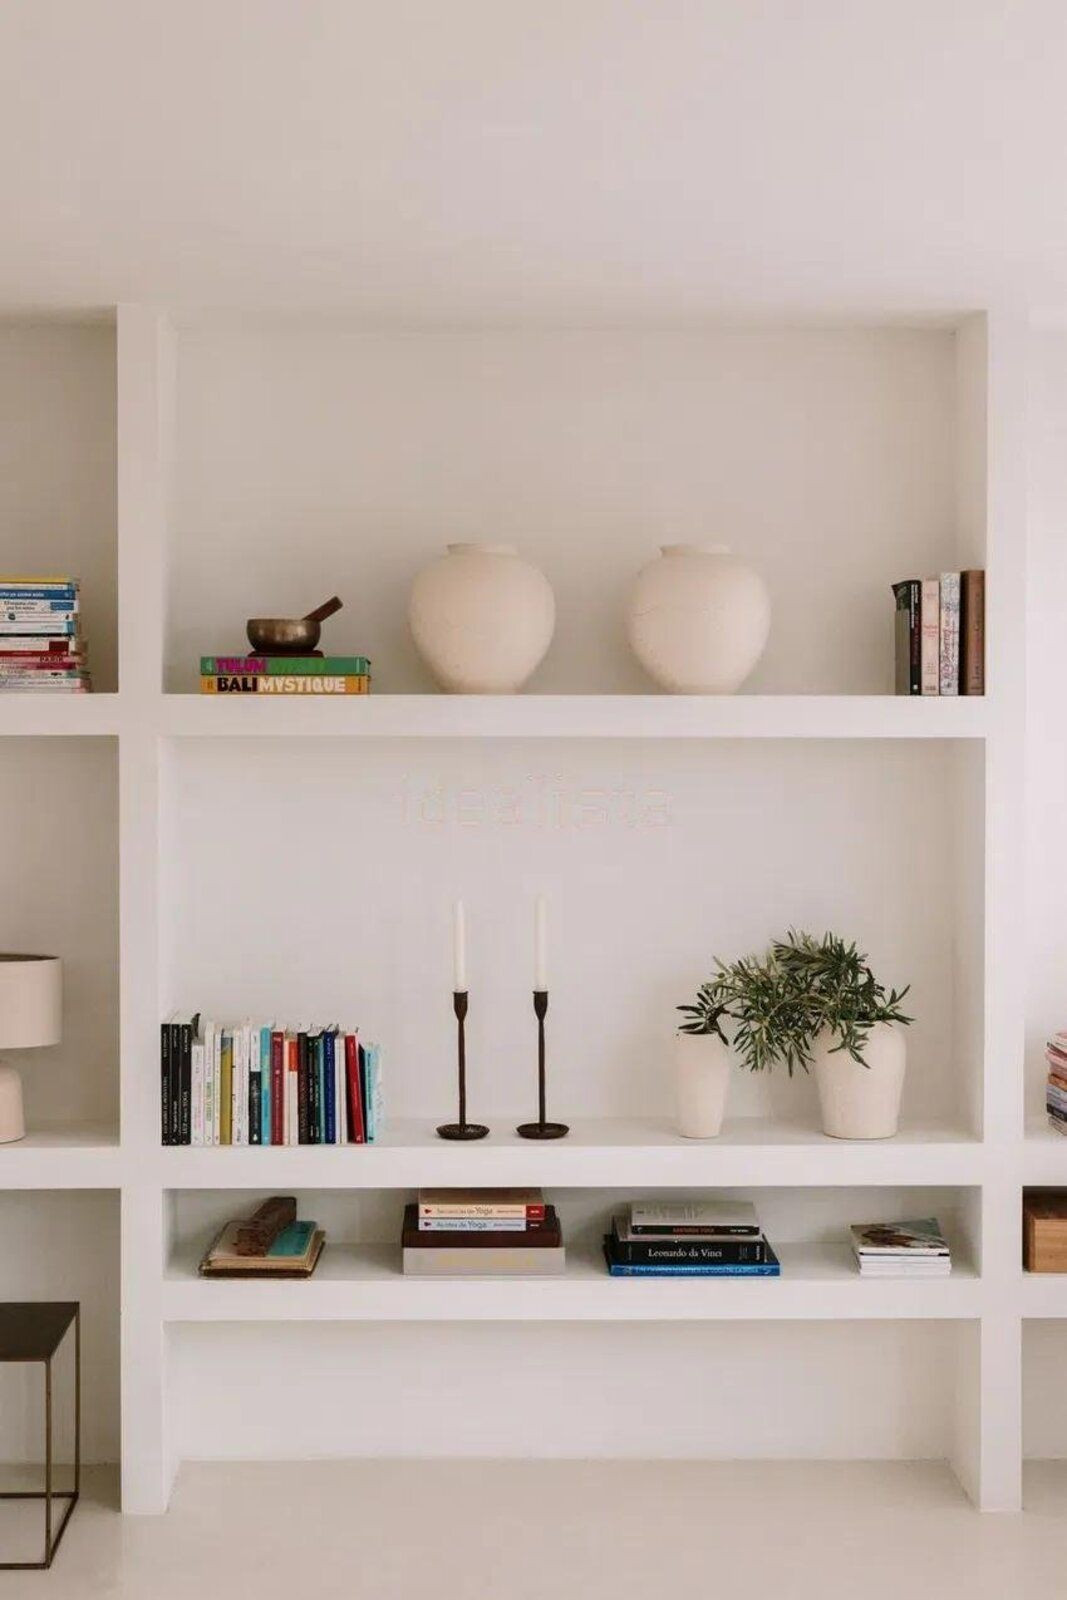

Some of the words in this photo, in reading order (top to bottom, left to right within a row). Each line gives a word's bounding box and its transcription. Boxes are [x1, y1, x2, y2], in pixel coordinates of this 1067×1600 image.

[217, 677, 258, 692] BALI
[258, 677, 346, 692] MYSTIQUE
[475, 1206, 493, 1216] Yoga
[467, 1219, 488, 1229] Yoga
[648, 1248, 687, 1258] Leonardo
[688, 1248, 699, 1258] da
[701, 1248, 723, 1258] Vinci
